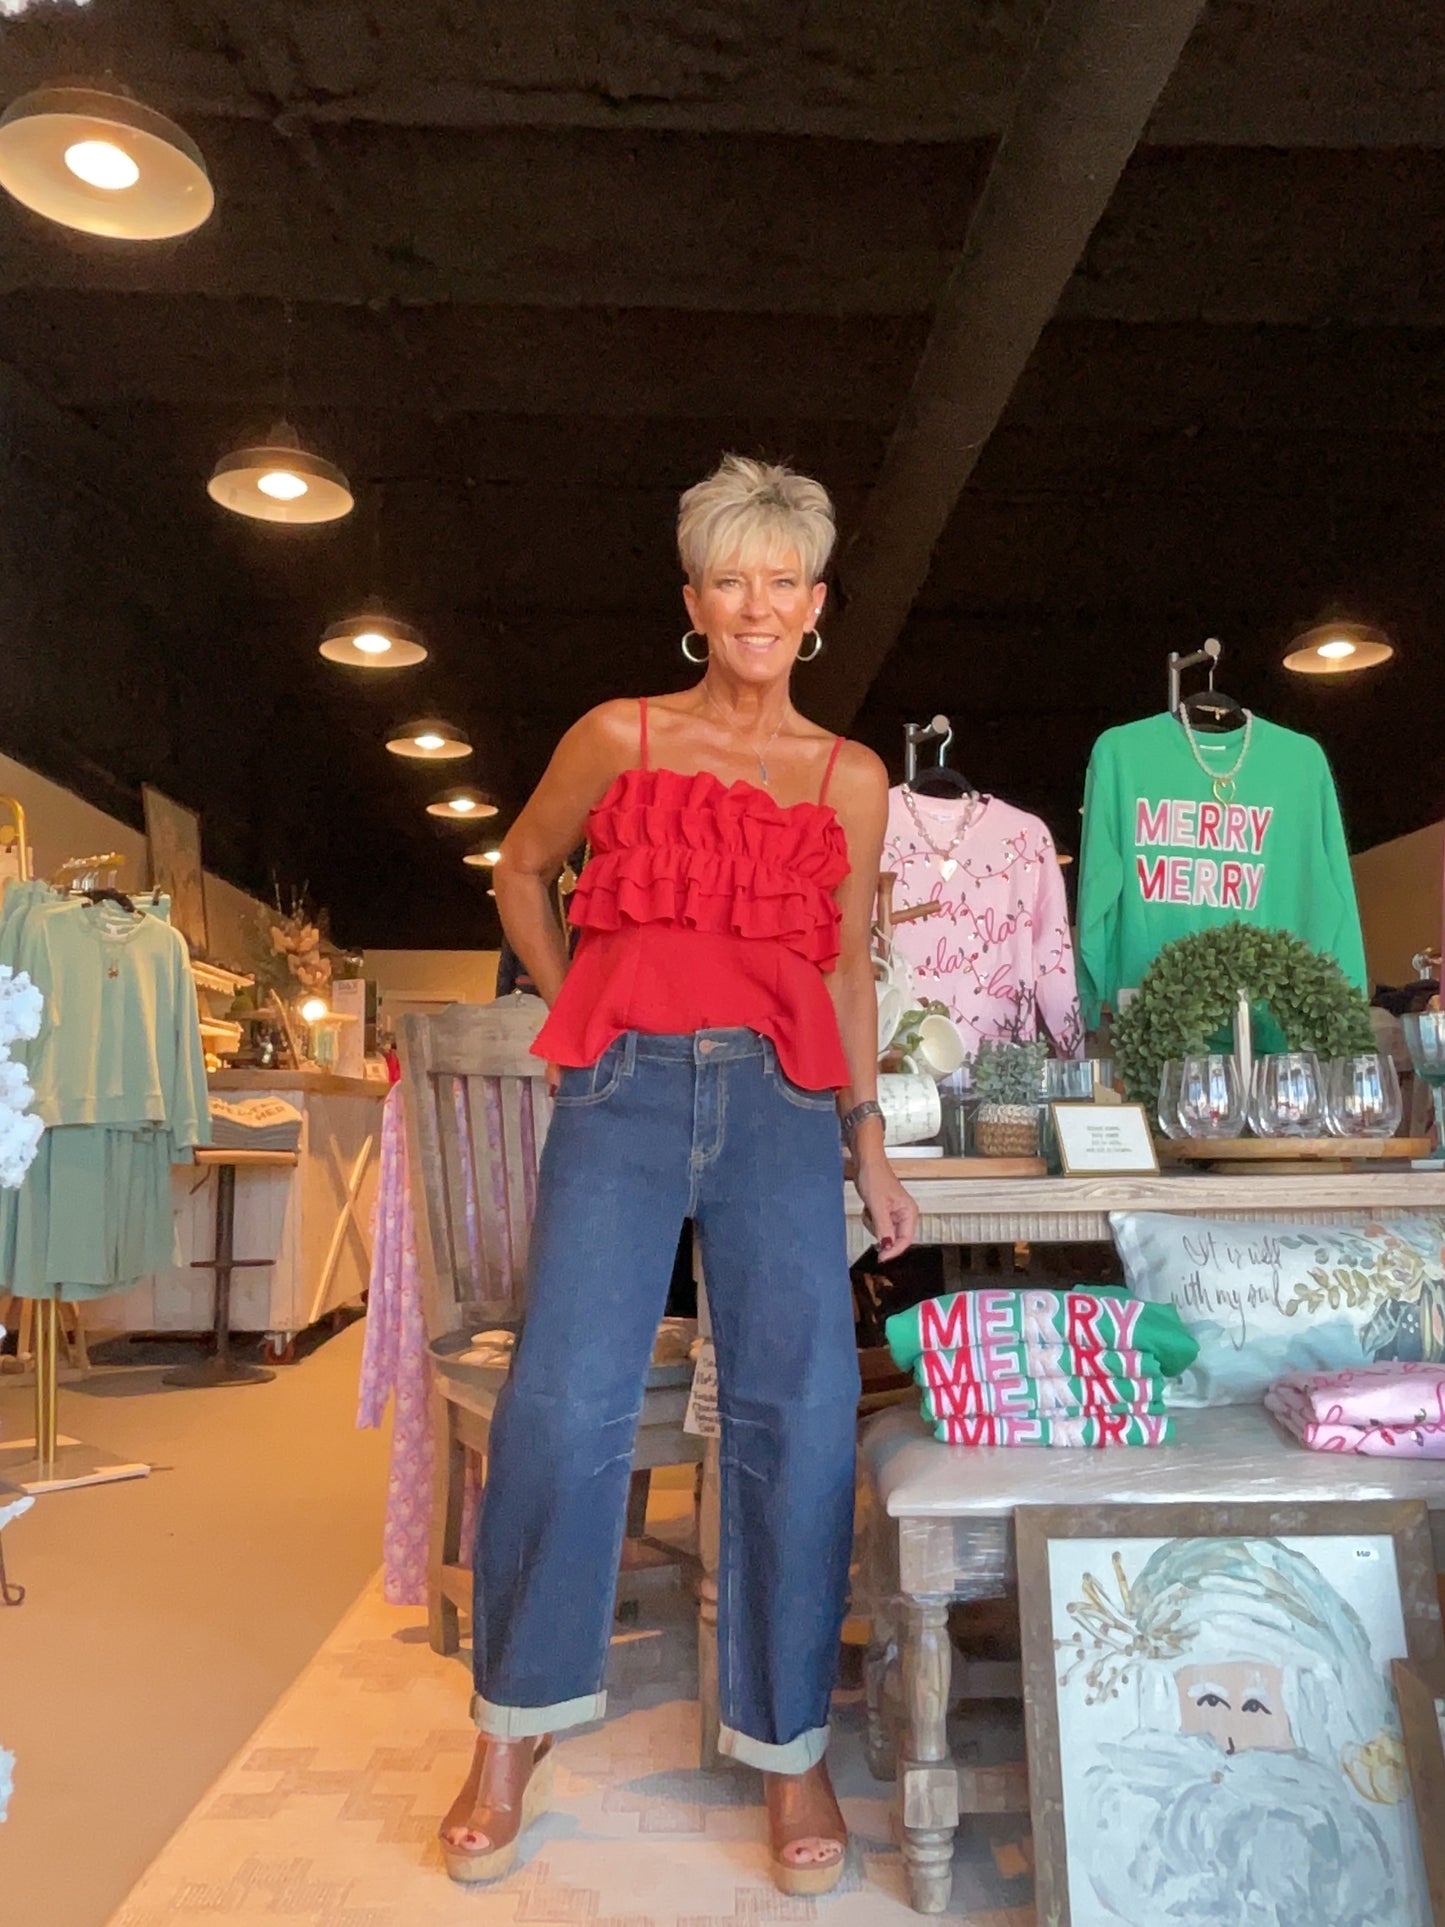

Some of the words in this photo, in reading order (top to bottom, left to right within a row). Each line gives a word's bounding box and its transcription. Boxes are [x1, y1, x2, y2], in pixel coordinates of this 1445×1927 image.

[1135, 798, 1274, 855] MERRY
[929, 881, 955, 918] la
[985, 907, 1017, 944] la
[1136, 855, 1265, 911] MERRY
[936, 936, 963, 973] la
[986, 964, 1016, 1000] la
[1182, 1231, 1221, 1272] It
[918, 1289, 1144, 1350] MERRY
[1170, 1270, 1214, 1313] with
[1215, 1289, 1246, 1352] my
[1246, 1269, 1287, 1316] soul
